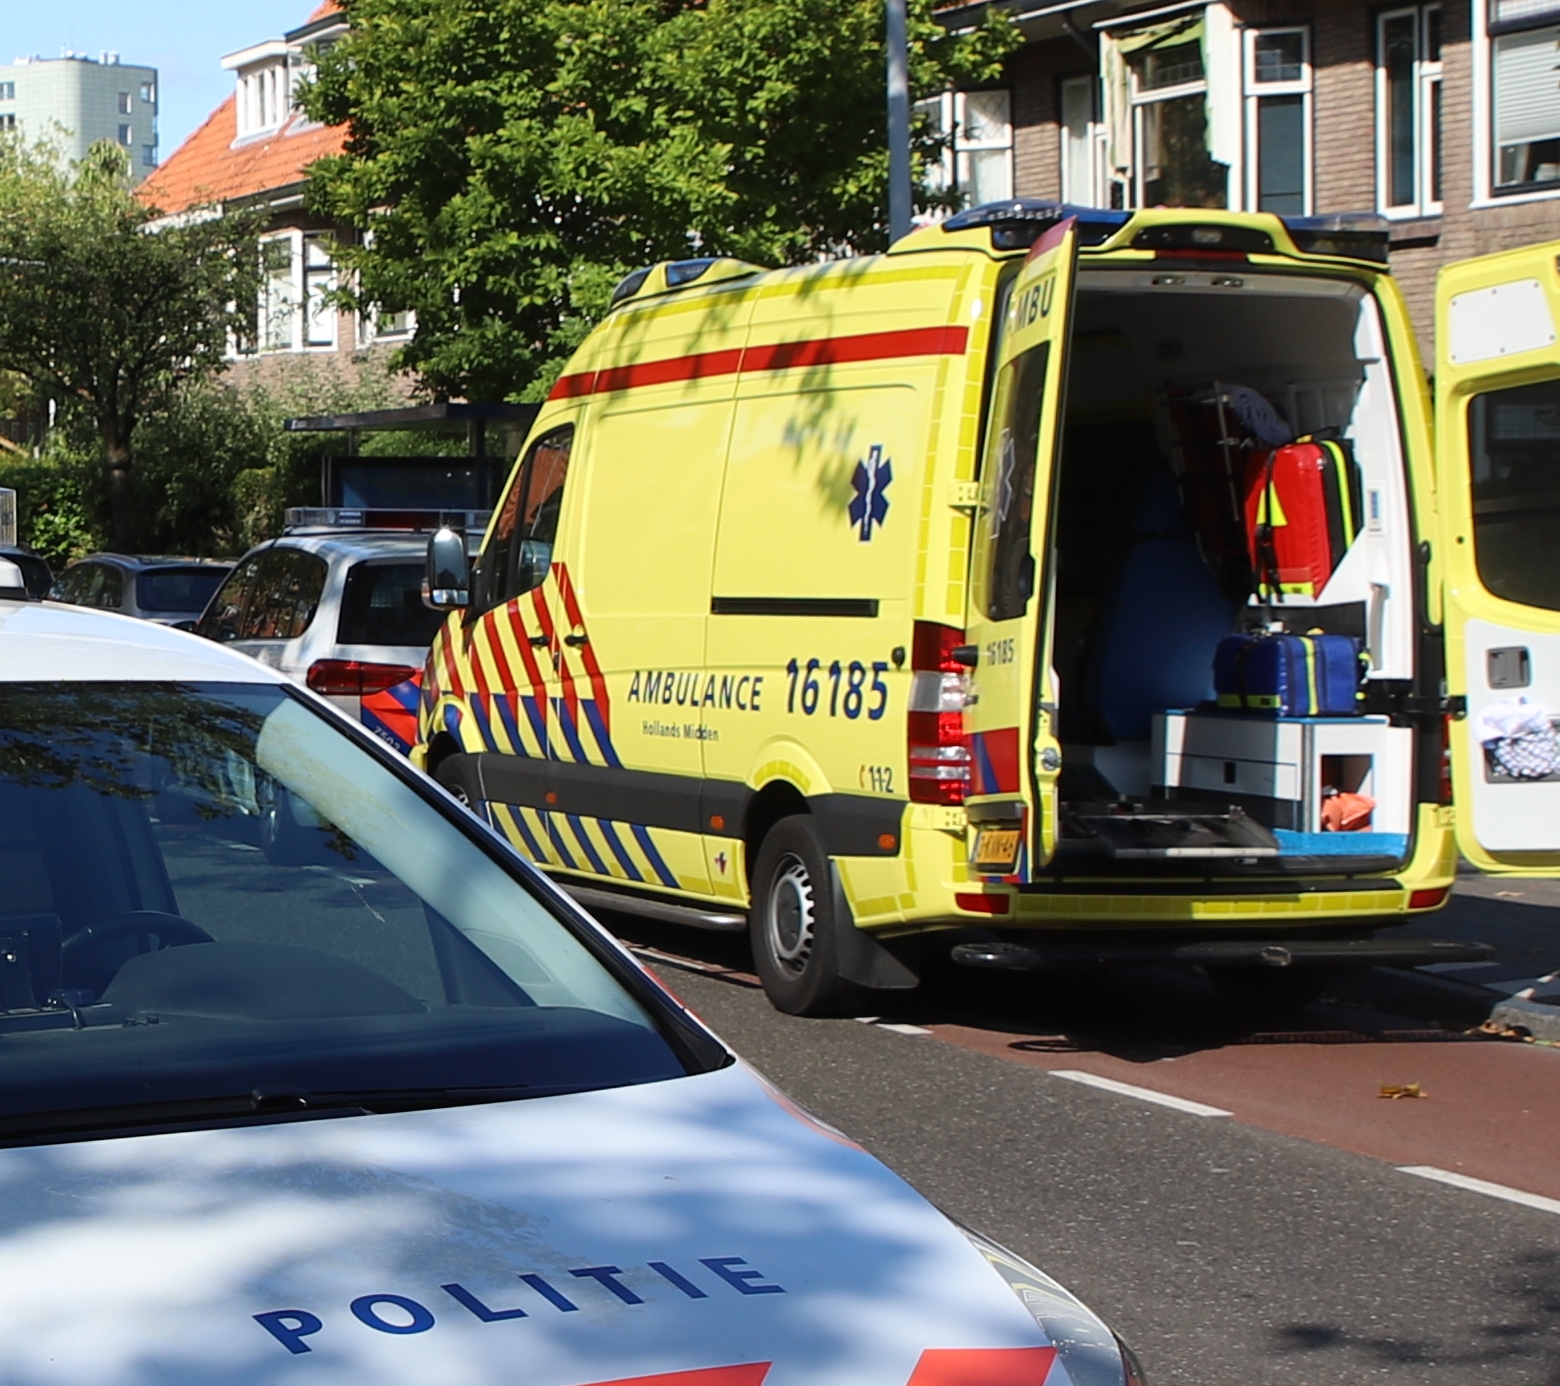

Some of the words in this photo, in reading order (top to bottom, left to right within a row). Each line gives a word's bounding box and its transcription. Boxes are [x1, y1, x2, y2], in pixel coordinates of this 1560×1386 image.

[627, 670, 764, 712] AMBULANCE
[786, 657, 890, 721] 16185
[642, 720, 681, 739] Hollands
[683, 723, 720, 742] Midden
[251, 1257, 787, 1355] POLITIE
